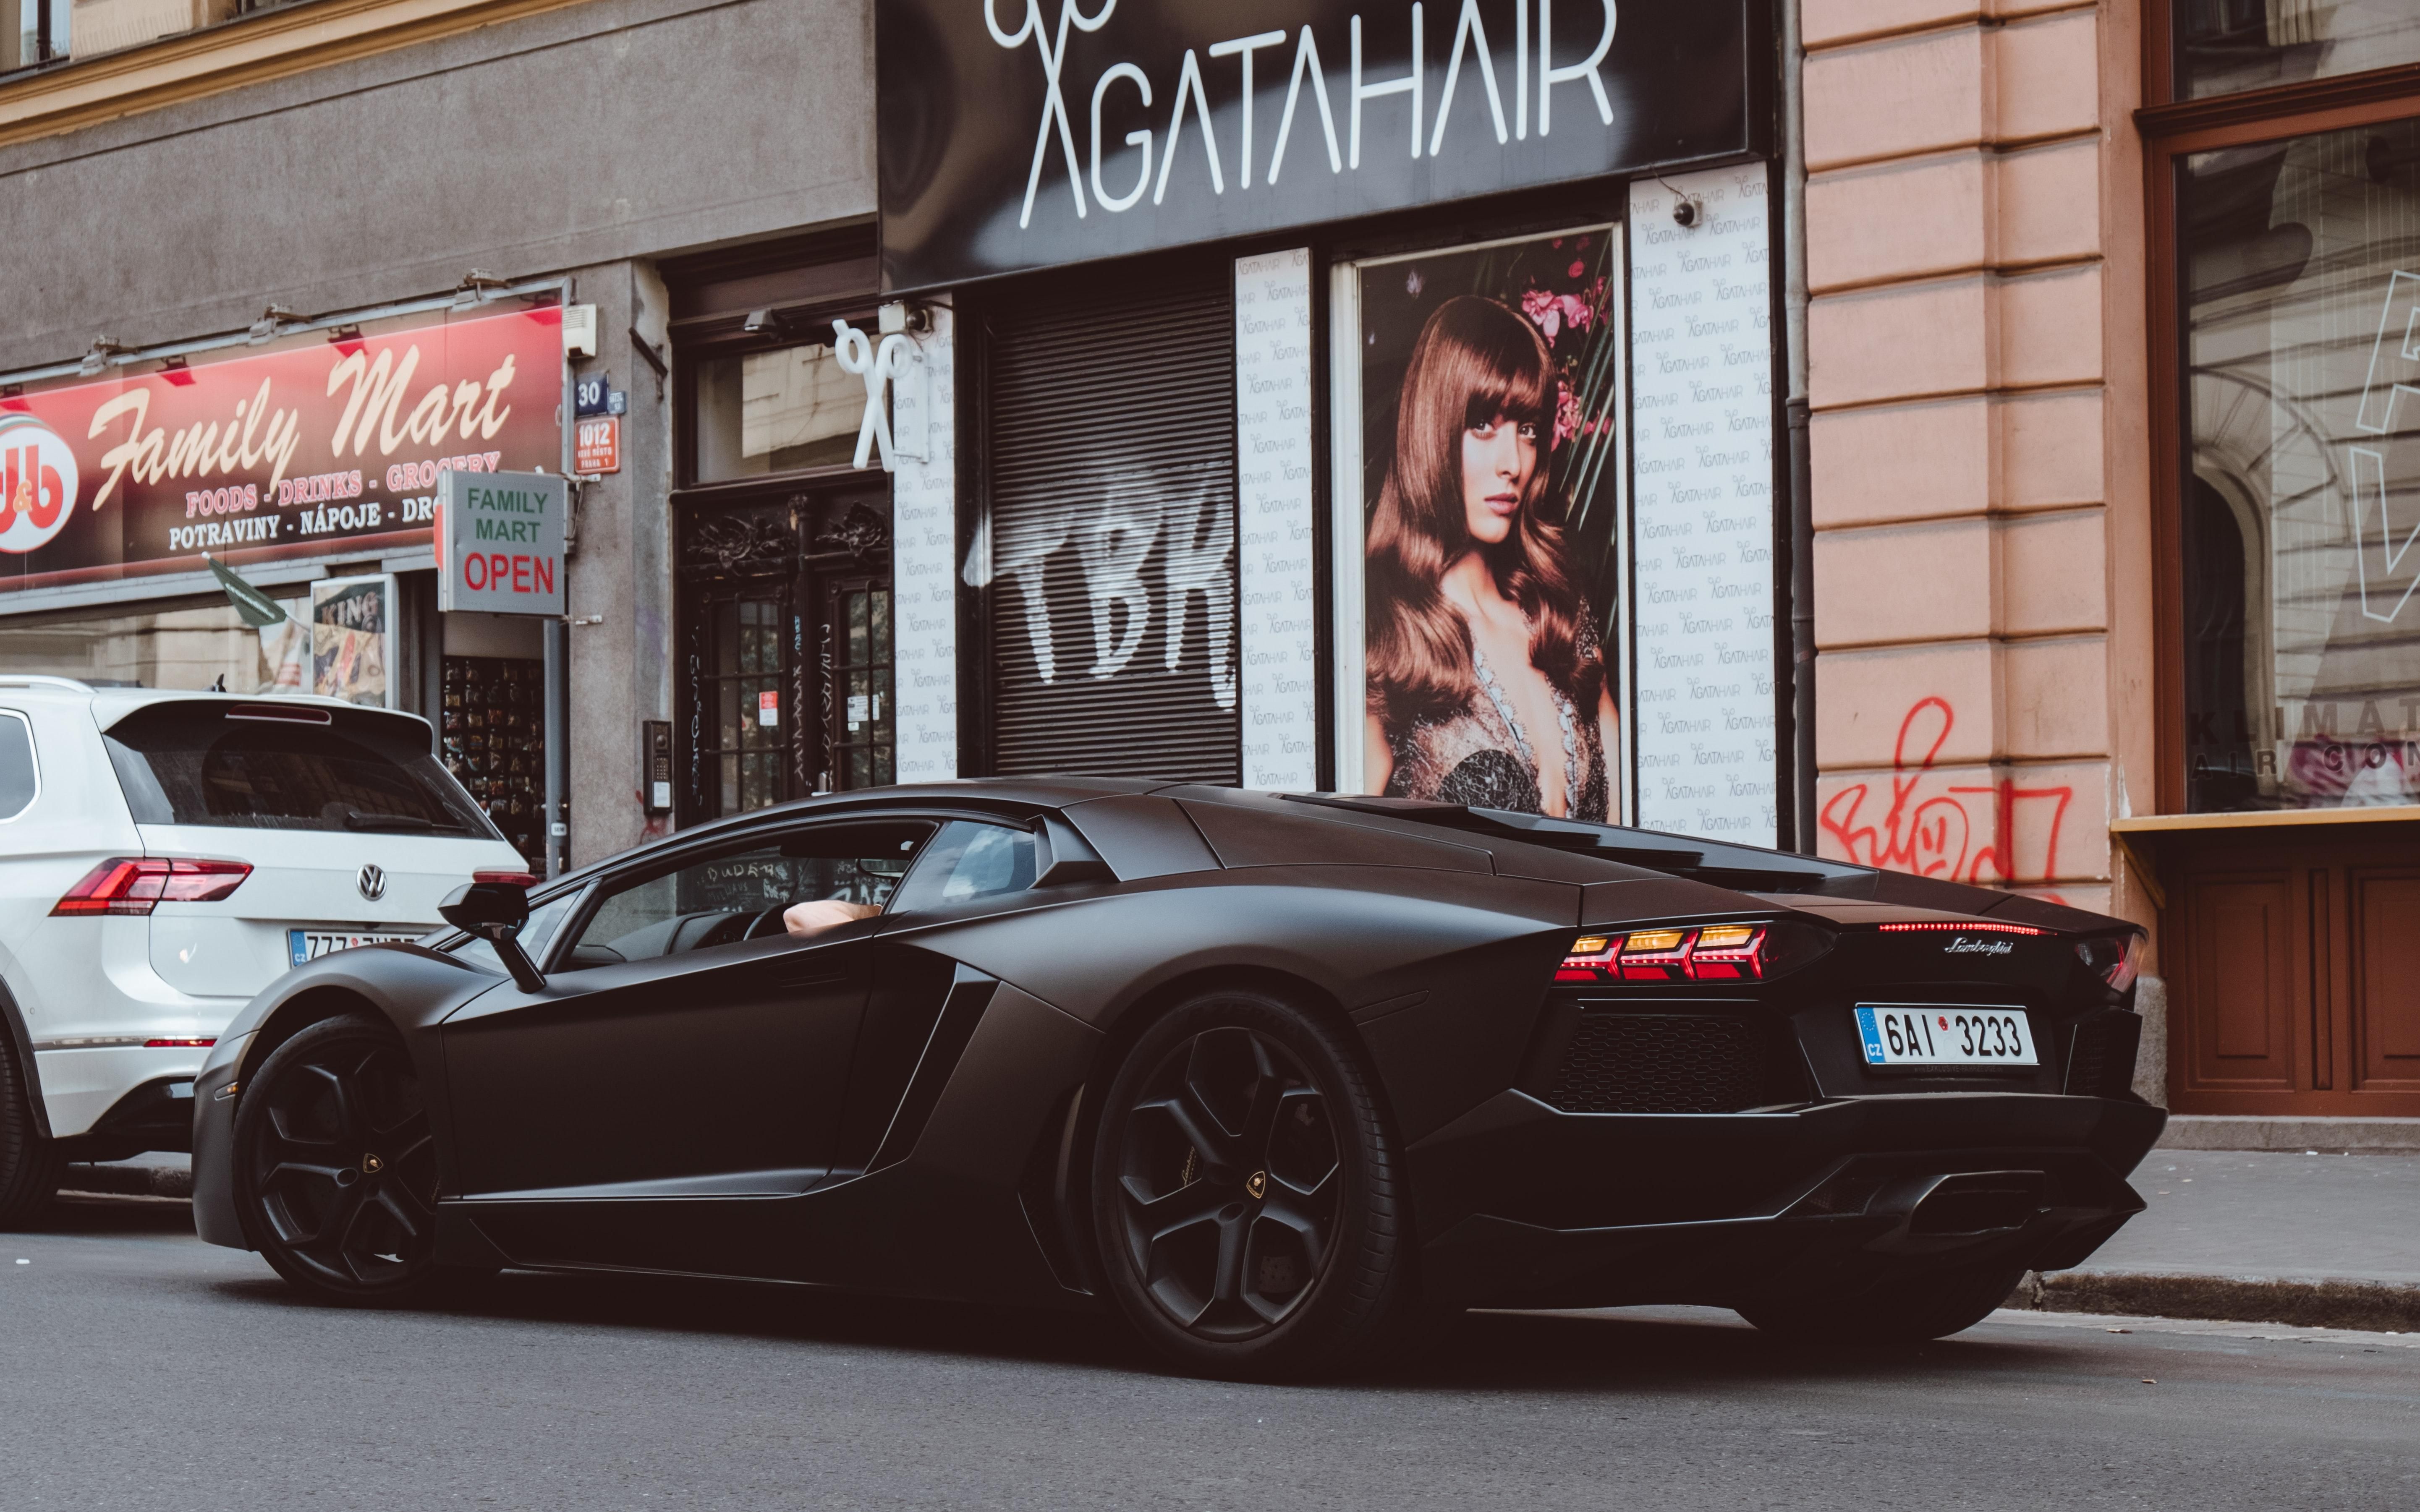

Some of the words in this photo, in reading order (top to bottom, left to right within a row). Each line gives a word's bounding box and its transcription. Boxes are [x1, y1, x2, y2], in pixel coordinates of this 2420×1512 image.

[1710, 217, 1761, 236] AGATAHAIR
[1237, 259, 1280, 275] AGATAHAIR
[1681, 254, 1731, 273] AGATAHAIR
[1716, 282, 1766, 301] AGATAHAIR
[1652, 291, 1702, 310] AGATAHAIR
[1243, 318, 1285, 335] AGATAHAIR
[1689, 319, 1739, 338] AGATAHAIR
[1660, 356, 1709, 374] AGATAHAIR
[578, 381, 599, 407] 30
[1250, 378, 1292, 394] AGATAHAIR
[1693, 385, 1742, 403] AGATAHAIR
[89, 377, 299, 510] Family
[327, 345, 515, 456] Mart
[579, 423, 610, 447] 1012
[1664, 421, 1714, 439] AGATAHAIR
[1253, 438, 1295, 454] AGATAHAIR
[1699, 450, 1750, 468] AGATAHAIR
[186, 483, 257, 518] FOODS
[278, 470, 363, 507] DRINKS
[467, 488, 548, 514] FAMILY
[1672, 487, 1721, 504] AGATAHAIR
[900, 507, 937, 520] AGATAHAIR
[1259, 498, 1301, 514] AGATAHAIR
[169, 514, 280, 550] POTRAVINY
[300, 503, 381, 535] NÁPOJE
[476, 518, 541, 543] MART
[1643, 523, 1692, 539] AGATAHAIR
[1707, 517, 1756, 533] AGATAHAIR
[906, 562, 942, 576] AGATAHAIR
[1265, 558, 1307, 574] AGATAHAIR
[1676, 553, 1726, 569] AGATAHAIR
[464, 552, 553, 594] OPEN
[1648, 588, 1697, 604] AGATAHAIR
[1711, 583, 1761, 599] AGATAHAIR
[322, 591, 378, 626] KING
[909, 619, 946, 632] AGATAHAIR
[1683, 619, 1733, 634] AGATAHAIR
[1246, 651, 1287, 666] AGATAHAIR
[1654, 653, 1703, 669] AGATAHAIR
[1719, 649, 1768, 665] AGATAHAIR
[913, 675, 950, 688] AGATAHAIR
[1690, 684, 1740, 700] AGATAHAIR
[1252, 711, 1294, 726] AGATAHAIR
[1661, 719, 1711, 734] AGATAHAIR
[1694, 750, 1744, 765] AGATAHAIR
[2190, 749, 2278, 781] AIR
[1256, 772, 1298, 786] AGATAHAIR
[1666, 785, 1715, 799] AGATAHAIR
[1701, 816, 1751, 831] AGATAHAIR
[1944, 937, 2013, 956] Lamborghini
[295, 953, 306, 962] CZ
[1868, 1043, 1882, 1056] CZ
[1955, 1015, 2022, 1056] 3233
